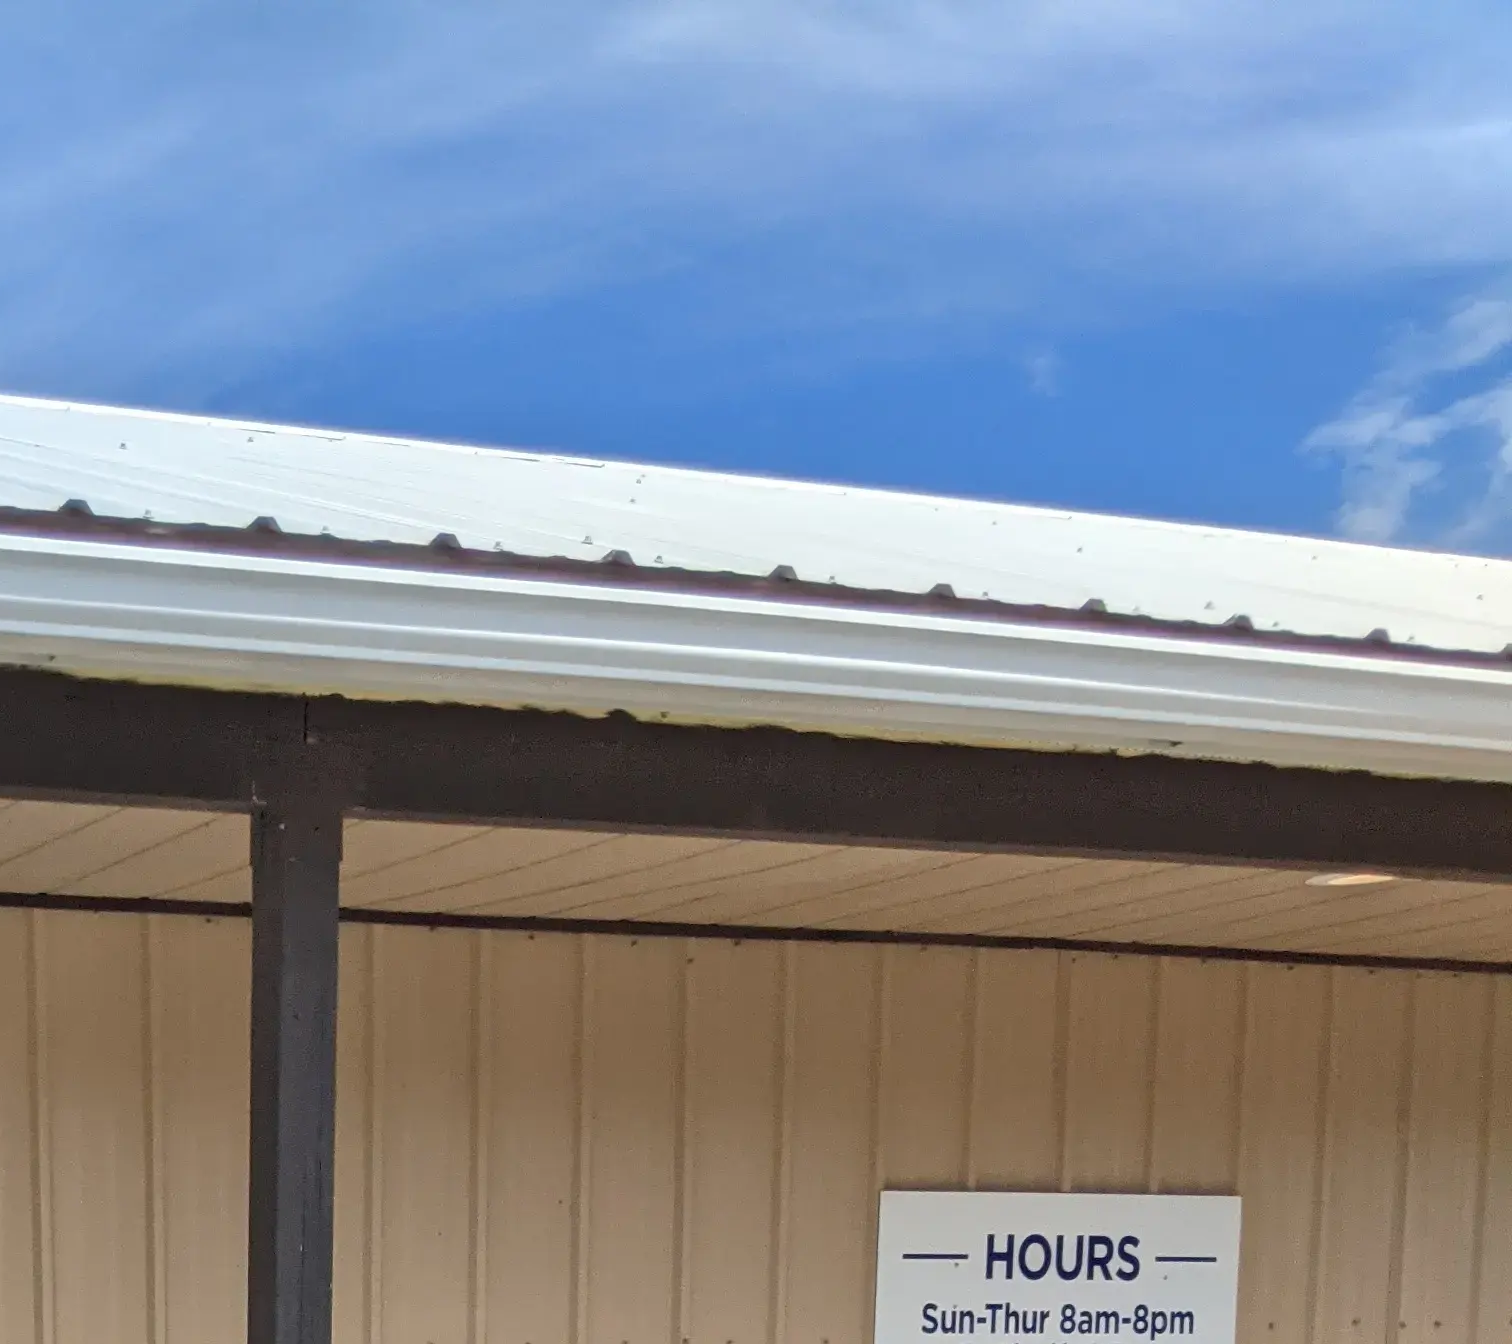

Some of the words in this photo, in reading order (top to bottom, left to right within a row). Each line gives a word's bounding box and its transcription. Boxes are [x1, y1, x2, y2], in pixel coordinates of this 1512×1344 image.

[985, 1234, 1140, 1281] HOURS
[921, 1302, 1050, 1334] Sun-Thur
[1060, 1304, 1194, 1341] 8am-8pm
